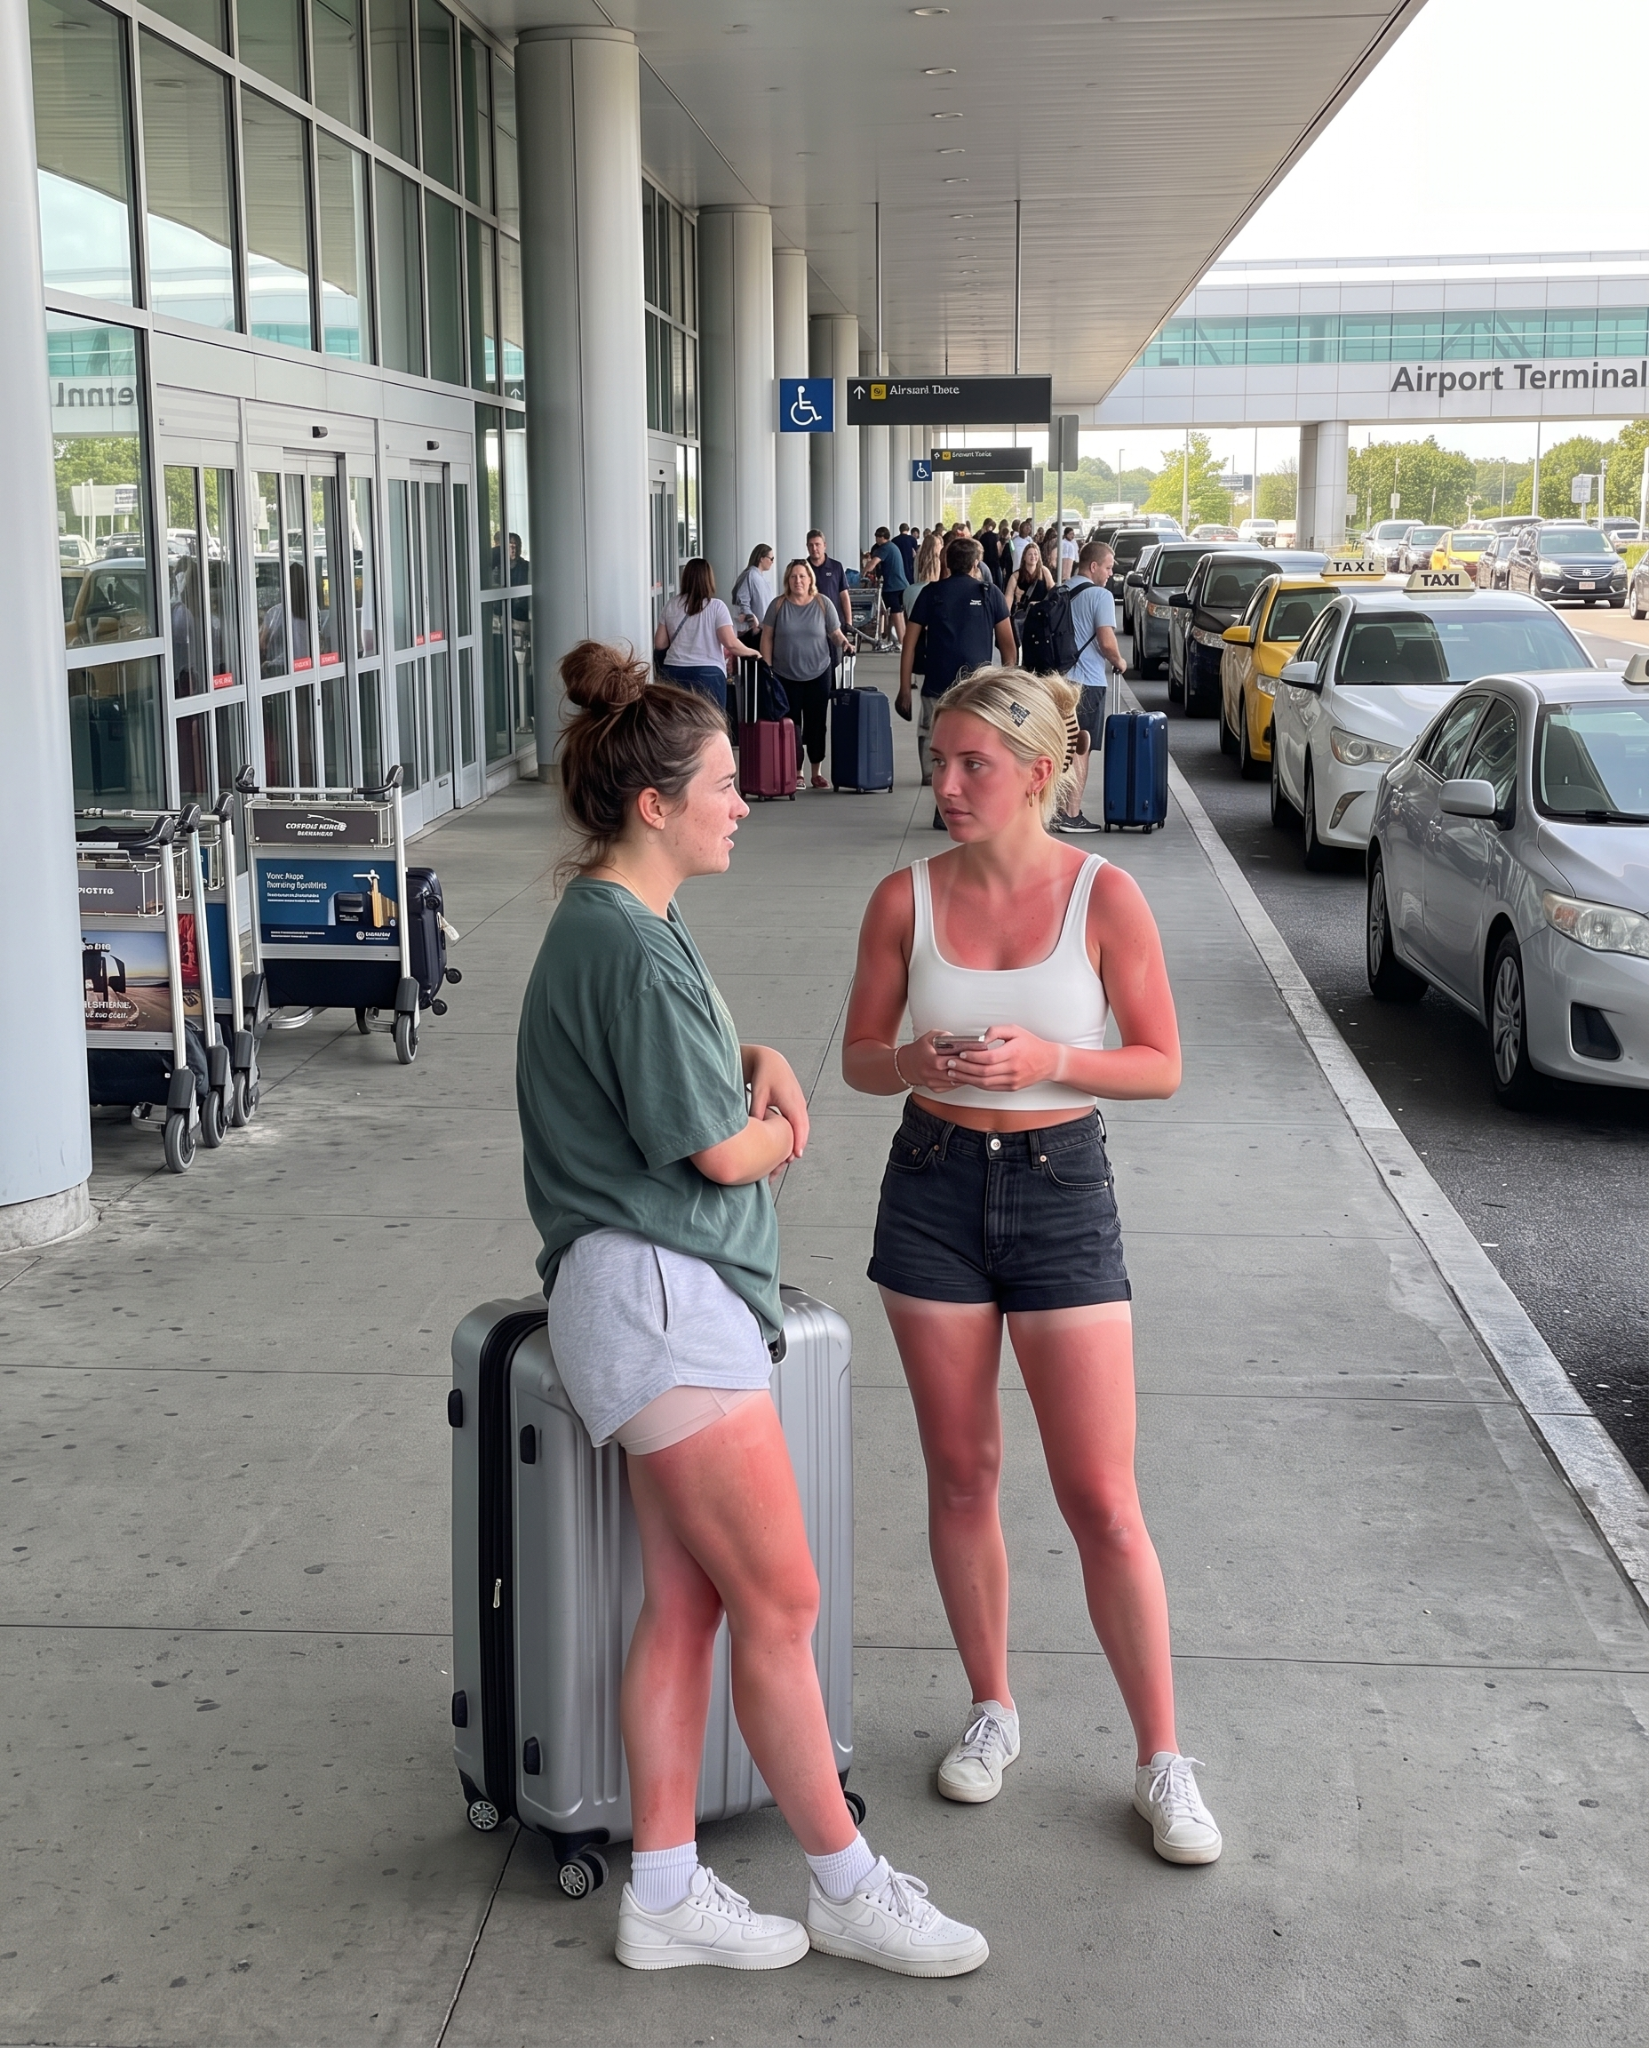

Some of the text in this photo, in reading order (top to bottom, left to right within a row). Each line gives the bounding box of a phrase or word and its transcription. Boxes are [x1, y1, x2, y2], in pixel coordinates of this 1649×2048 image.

[1390, 360, 1648, 398] Airport Terminal
[1421, 573, 1460, 587] TAXI
